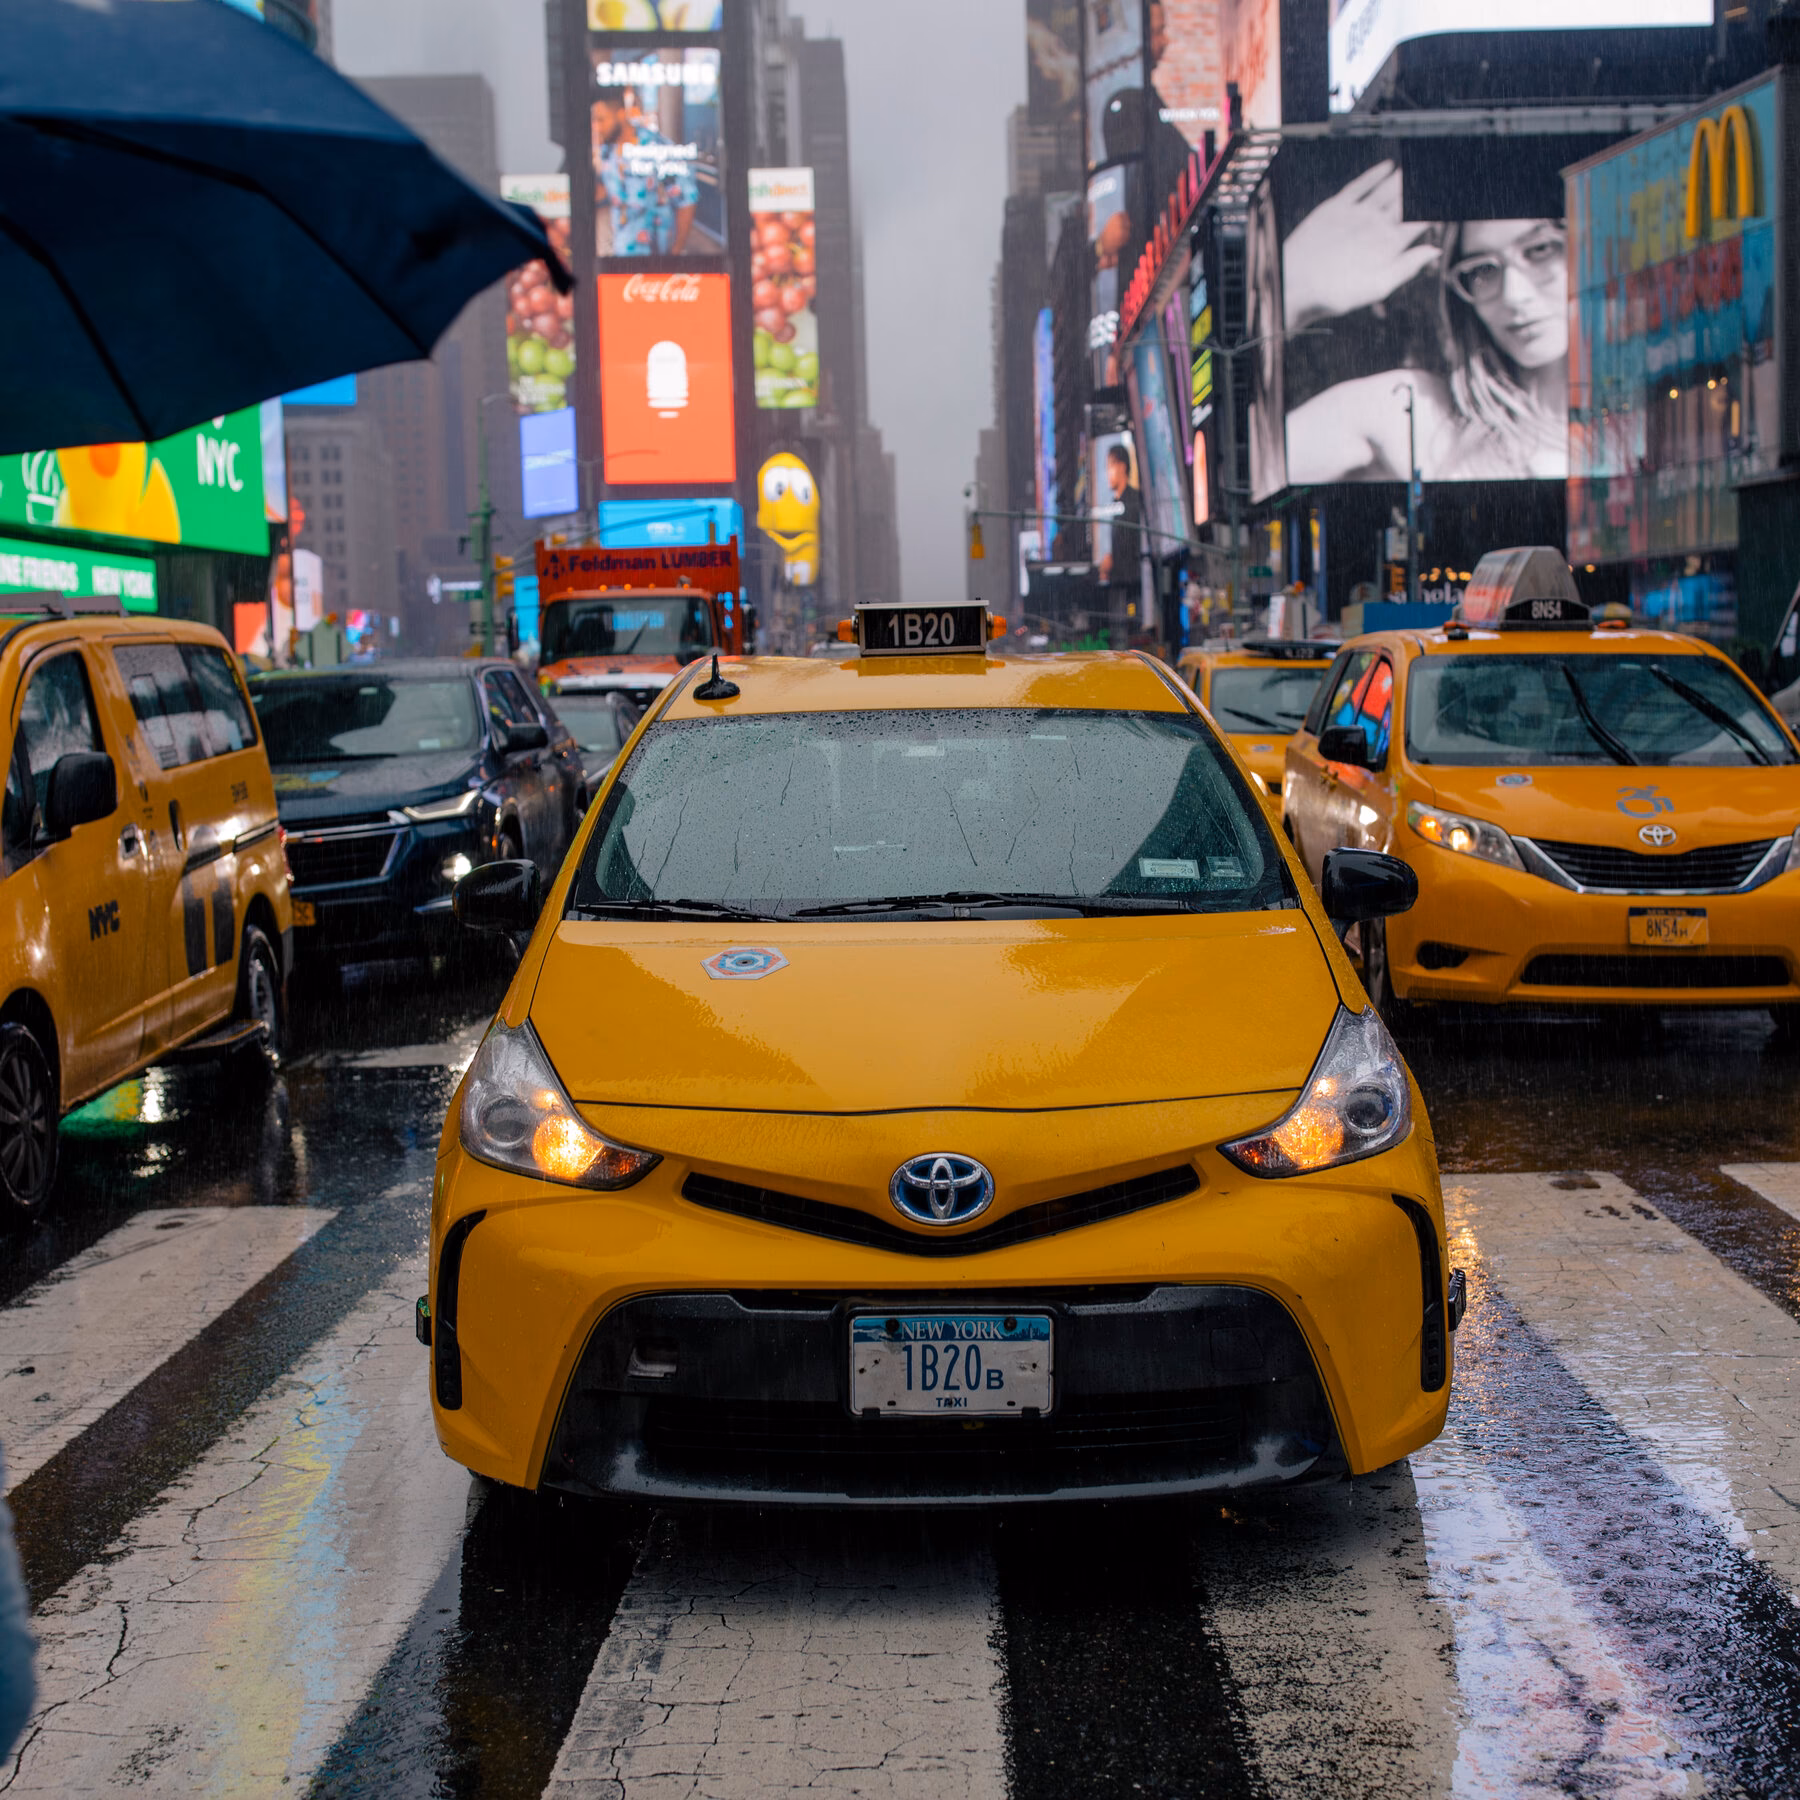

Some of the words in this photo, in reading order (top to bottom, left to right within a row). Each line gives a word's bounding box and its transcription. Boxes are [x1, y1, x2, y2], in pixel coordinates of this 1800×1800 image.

[597, 62, 716, 87] SAMSUNG
[196, 433, 244, 492] NYC
[568, 554, 657, 572] Feldman
[661, 550, 732, 569] LUMBER
[1531, 600, 1562, 619] 8N54
[888, 612, 955, 647] 1B20
[88, 899, 120, 942] NYC
[901, 1320, 945, 1340] NEW
[951, 1320, 1004, 1340] YORK
[935, 1397, 968, 1408] TAXI
